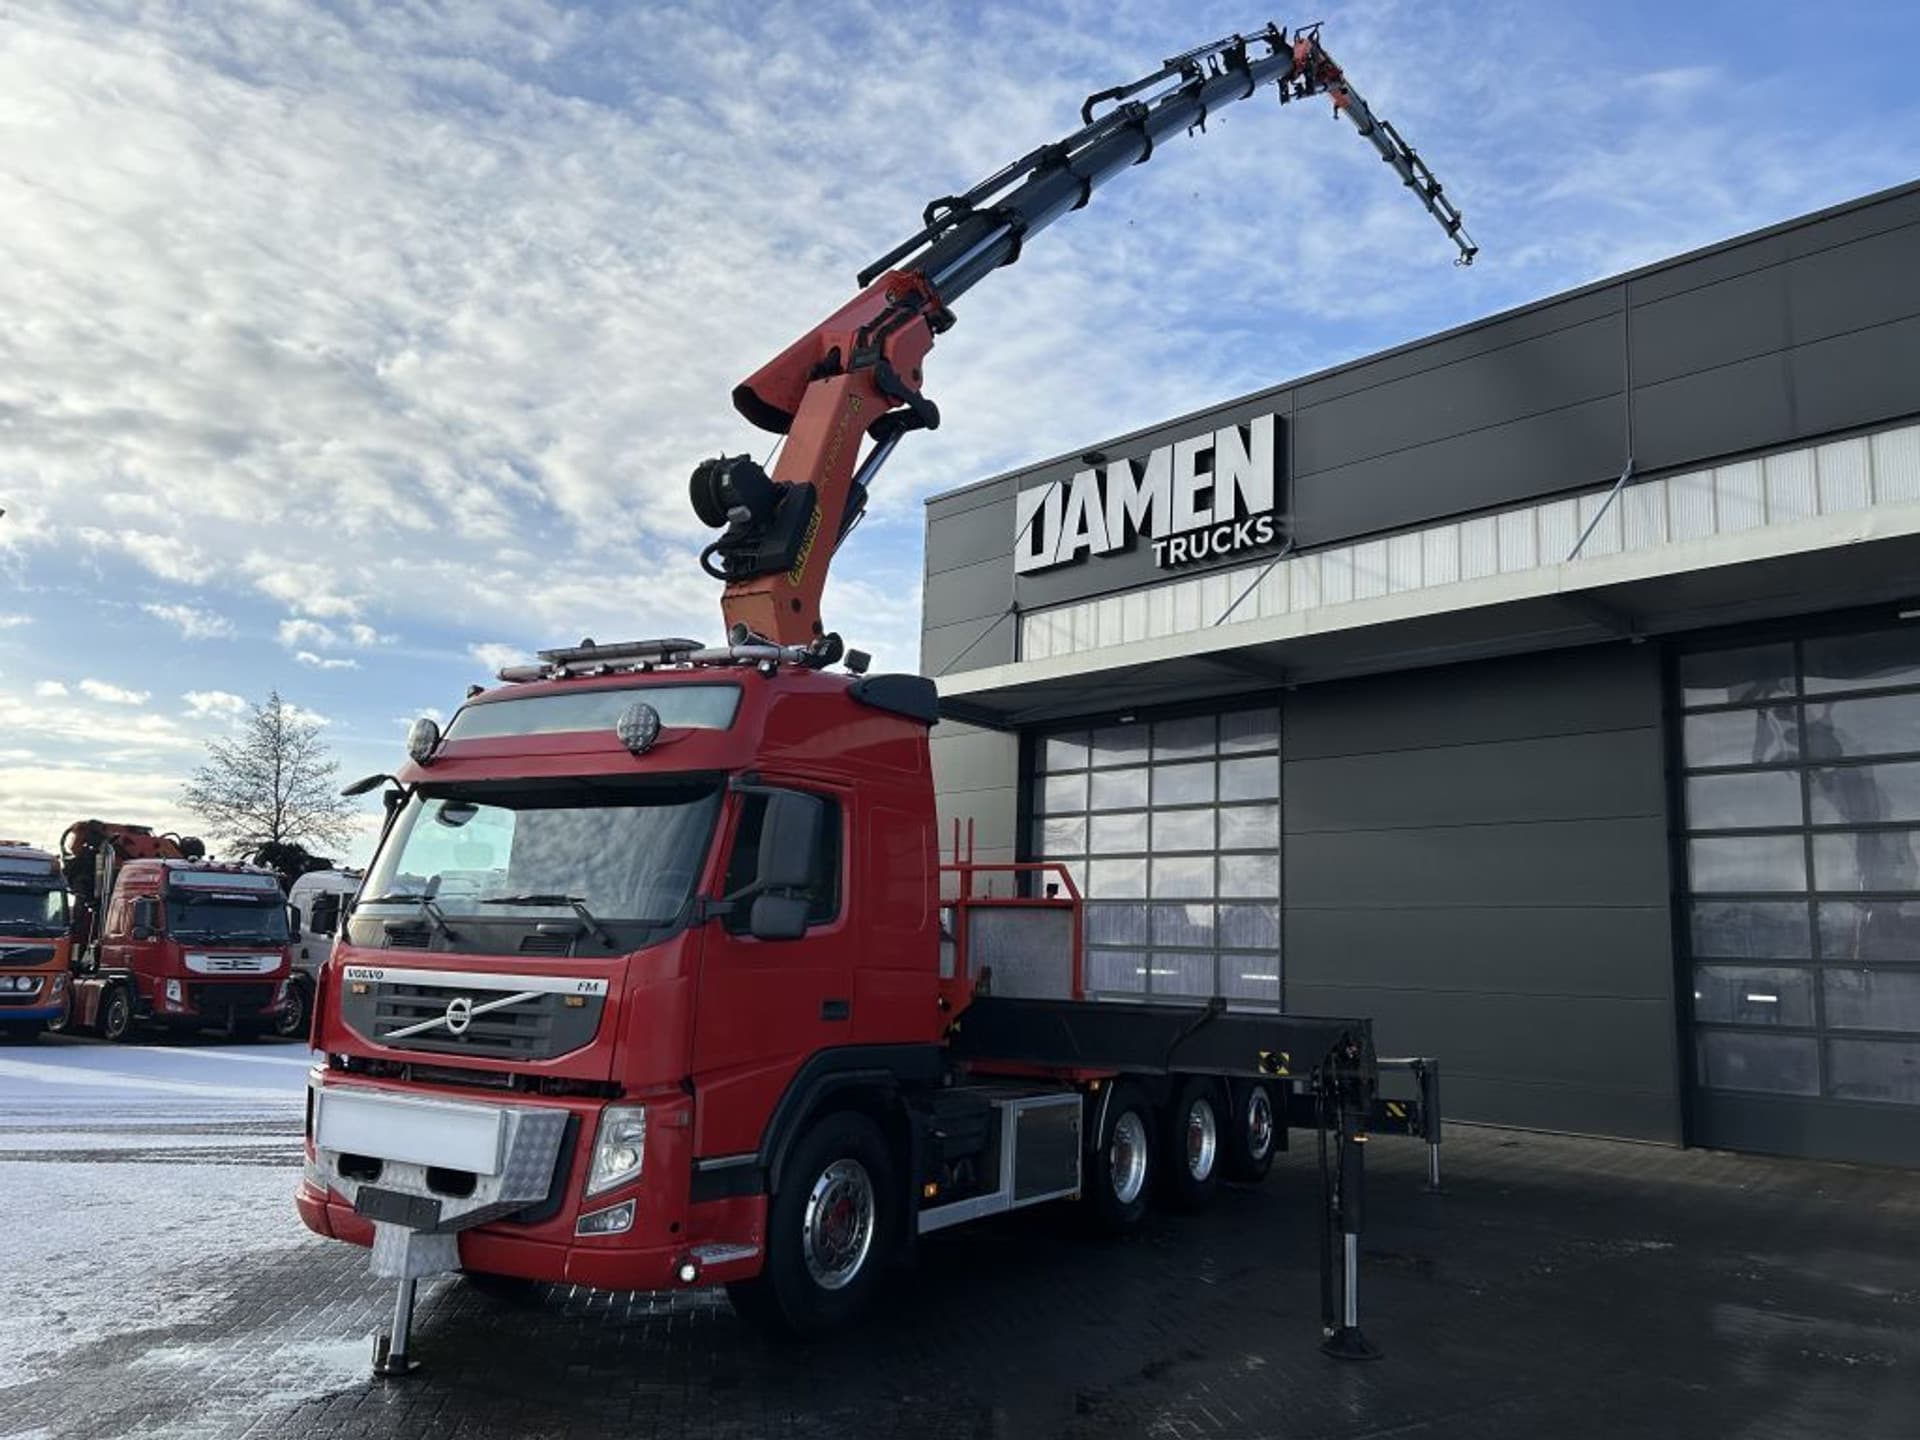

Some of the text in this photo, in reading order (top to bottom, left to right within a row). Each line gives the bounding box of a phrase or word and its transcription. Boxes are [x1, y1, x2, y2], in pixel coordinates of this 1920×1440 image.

[1014, 413, 1275, 574] DAMEN
[1151, 515, 1275, 568] TRUCKS
[347, 968, 384, 980] VOLVO
[577, 981, 599, 992] FM
